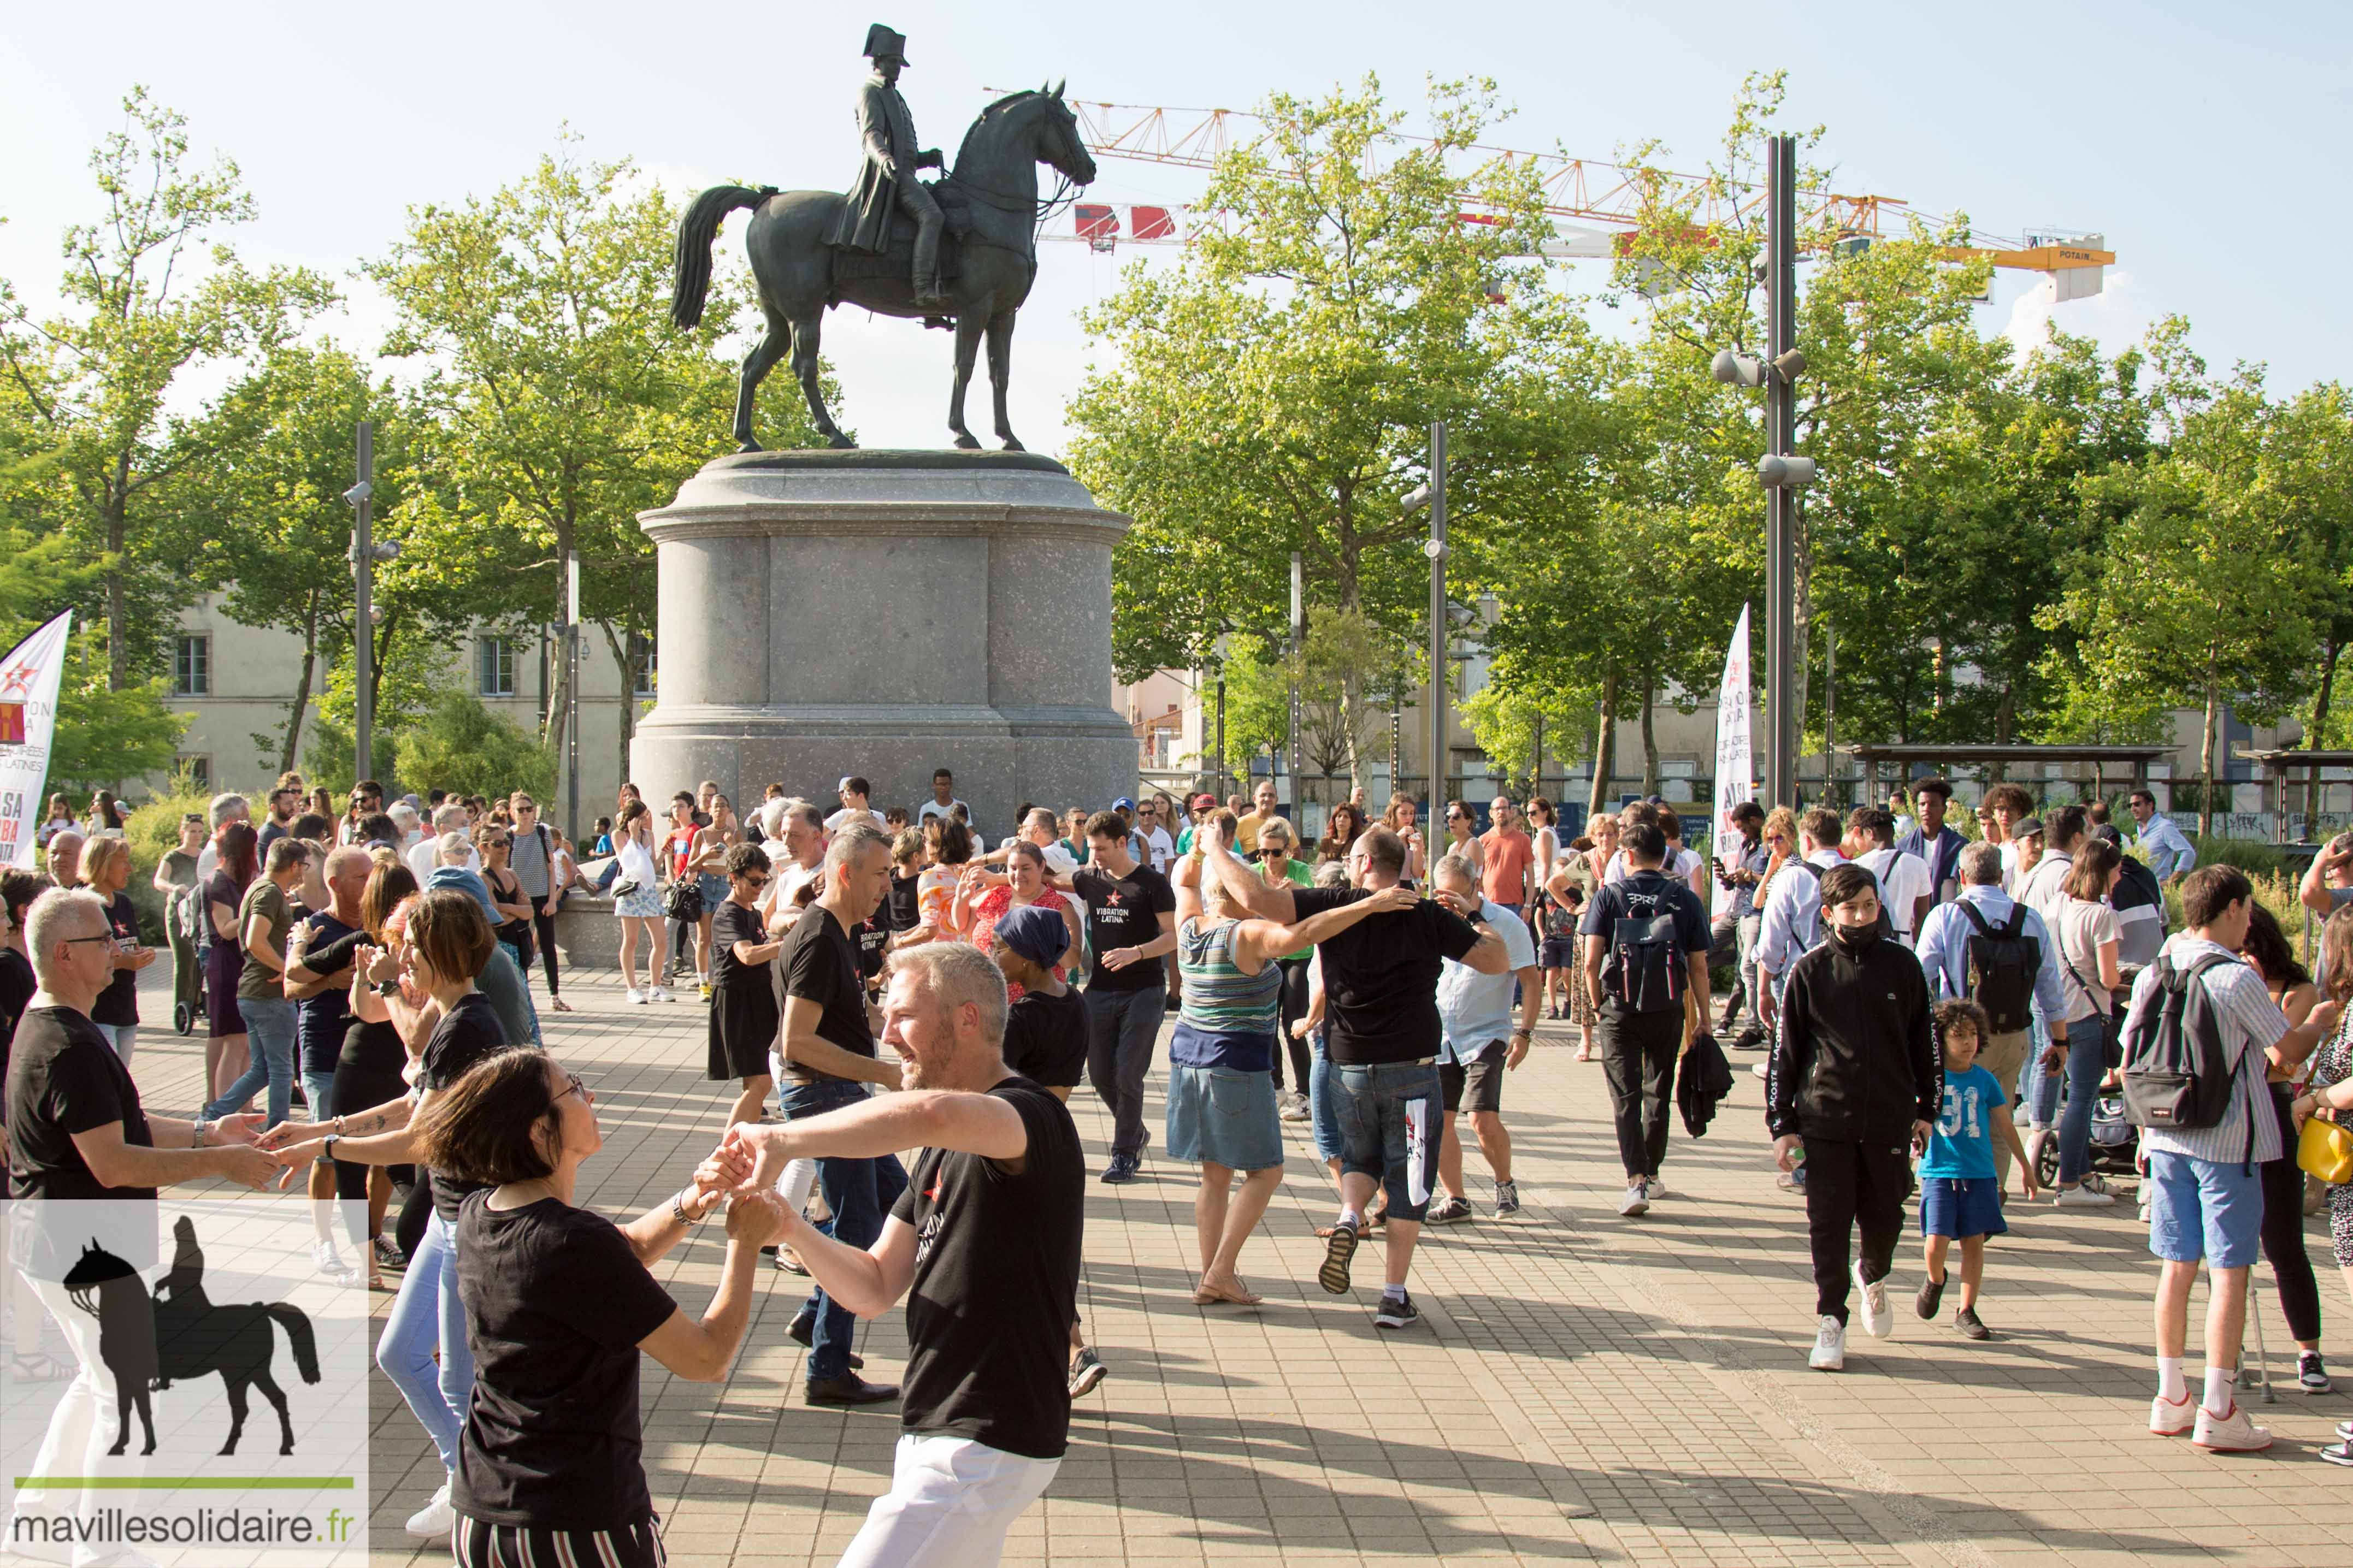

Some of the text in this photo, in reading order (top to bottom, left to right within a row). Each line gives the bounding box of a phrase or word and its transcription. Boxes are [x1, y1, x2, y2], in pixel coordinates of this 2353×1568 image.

[2060, 250, 2090, 261] POTAIN
[1096, 907, 1129, 916] VIBRATION
[1101, 915, 1123, 924] LATINA
[1930, 1022, 1941, 1067] LACOSTE
[1770, 1069, 1778, 1112] LACOSTE
